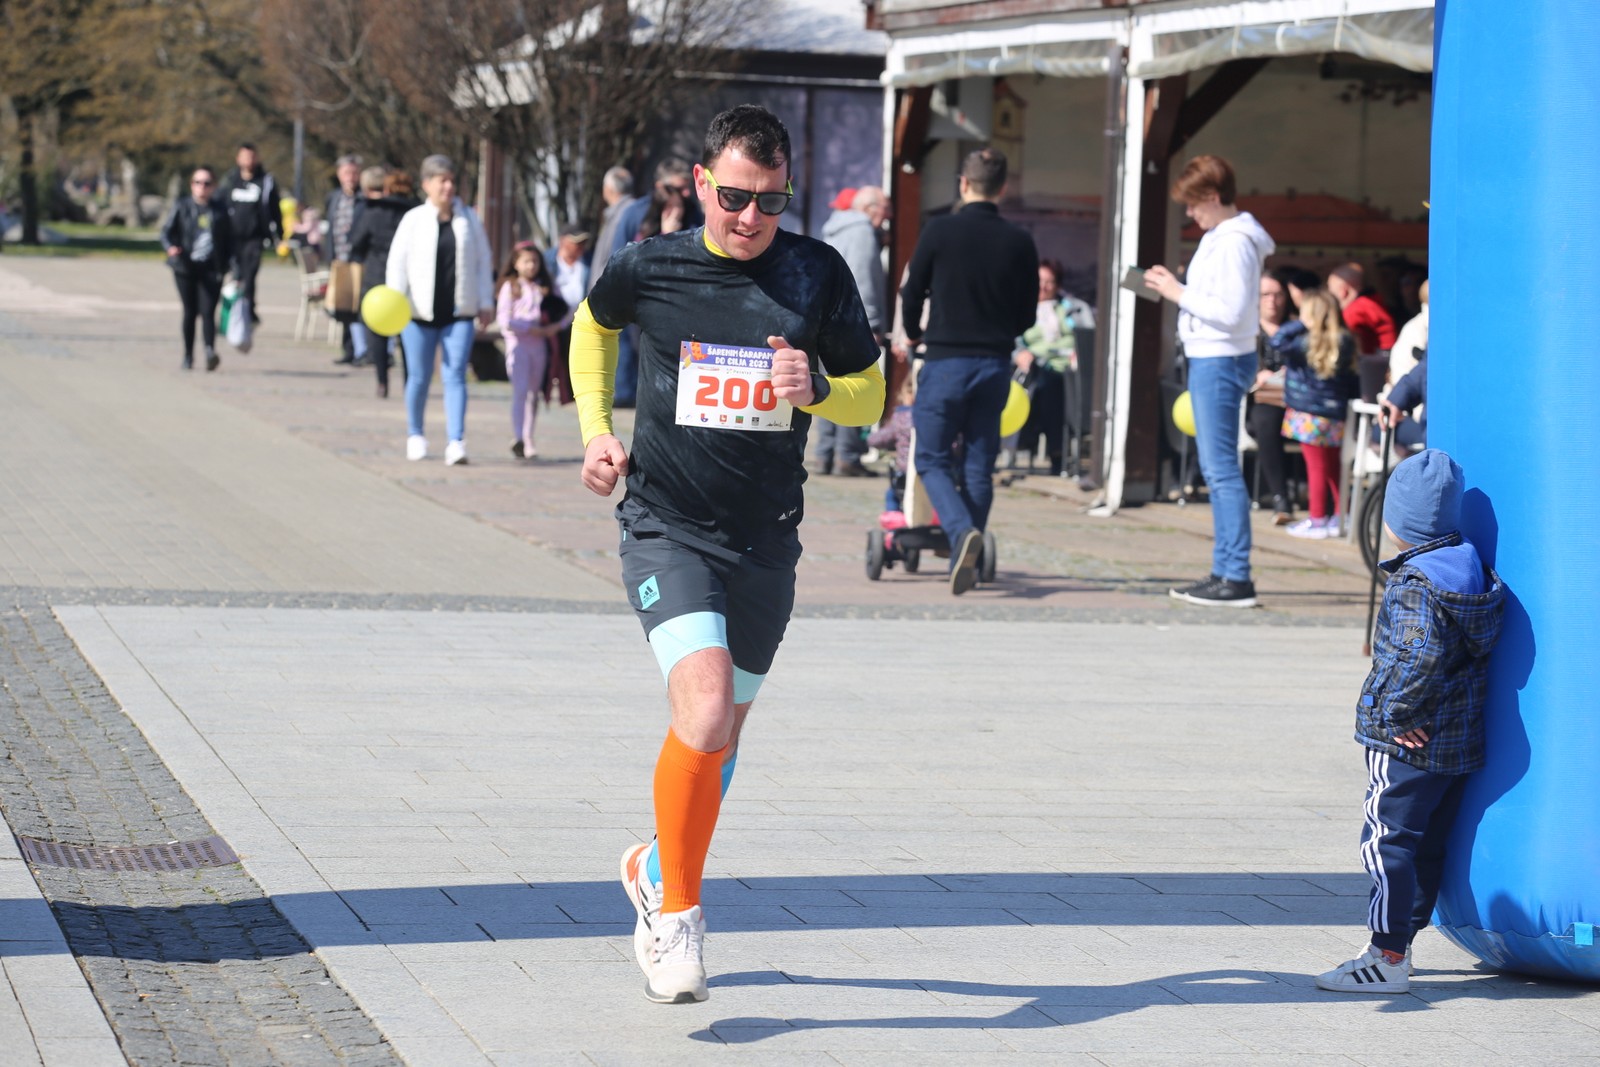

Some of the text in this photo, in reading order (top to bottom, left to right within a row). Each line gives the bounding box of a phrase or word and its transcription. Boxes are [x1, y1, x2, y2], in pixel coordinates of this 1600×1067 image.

[707, 346, 738, 357] ŠARENIM
[715, 357, 725, 365] DO
[727, 358, 747, 367] CILJA
[695, 375, 777, 411] 200
